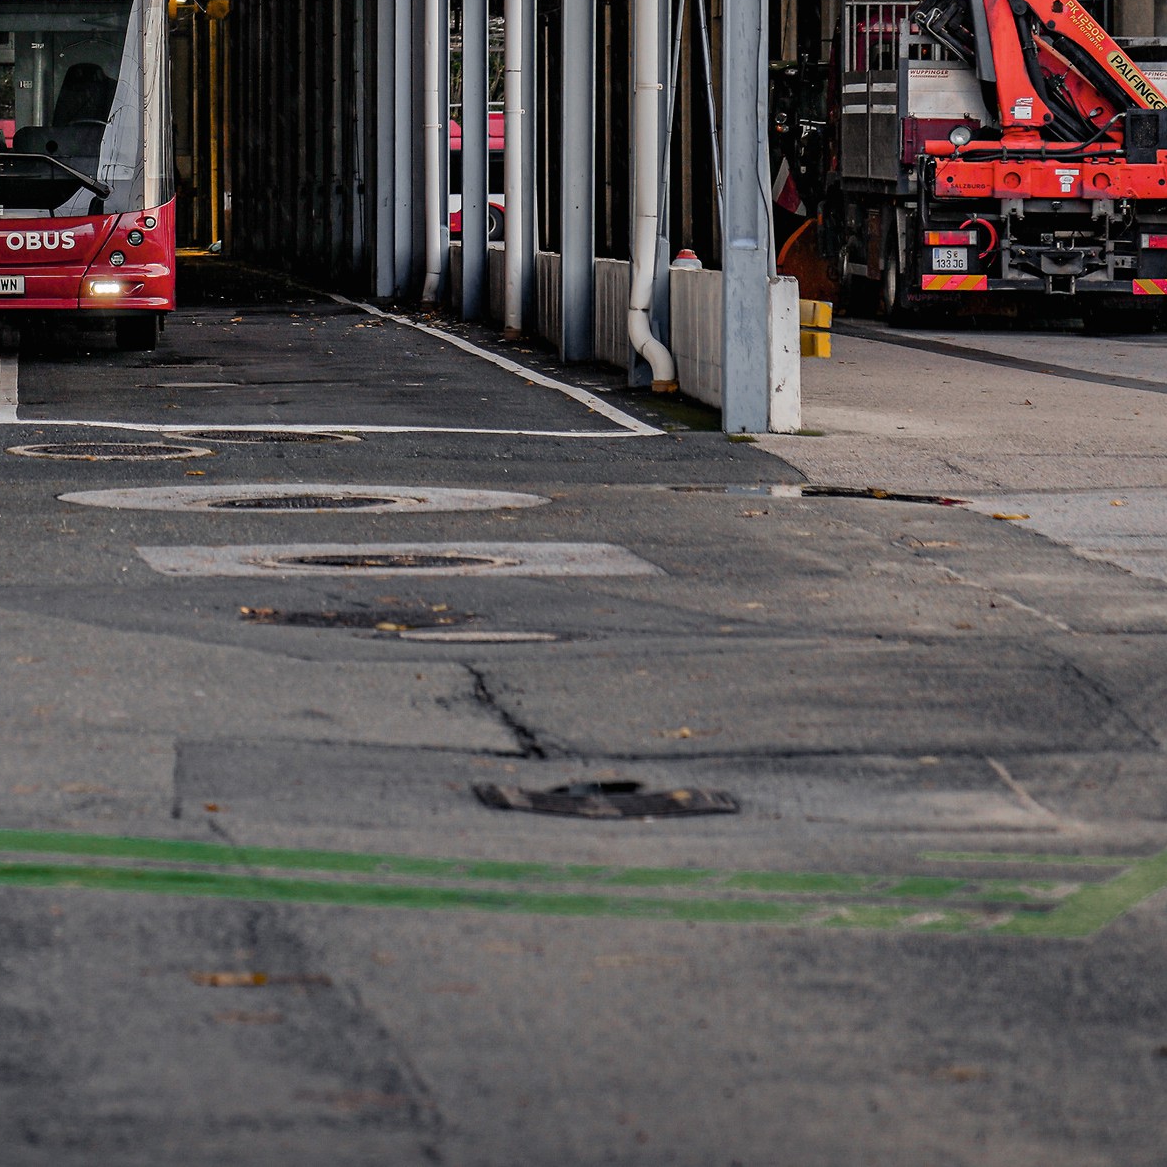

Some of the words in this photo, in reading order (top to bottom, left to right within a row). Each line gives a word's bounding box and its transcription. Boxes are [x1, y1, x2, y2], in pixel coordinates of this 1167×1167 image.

[1066, 0, 1080, 15] PK
[1077, 13, 1105, 42] 12502
[1070, 15, 1104, 51] Performance
[6, 231, 76, 250] OBUS
[946, 250, 952, 259] S
[936, 259, 951, 268] 133
[953, 259, 964, 268] JG
[1, 279, 17, 291] WN
